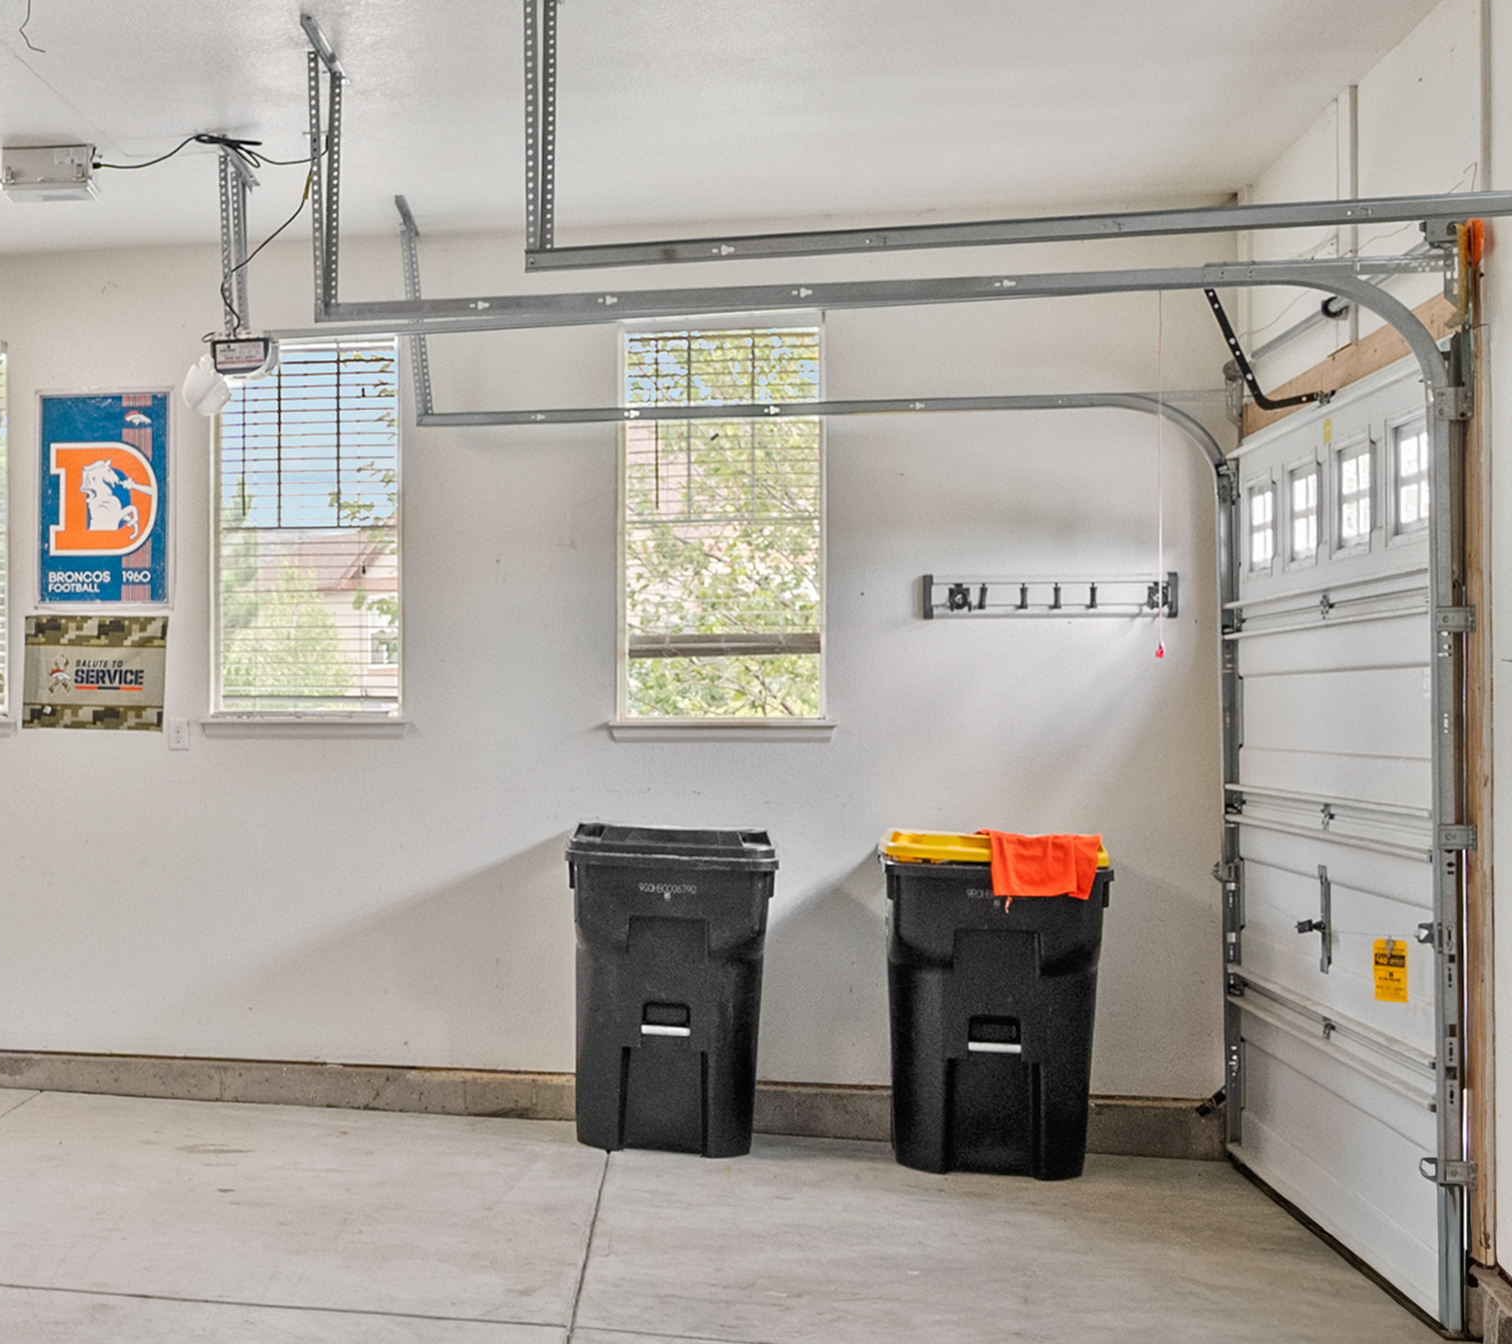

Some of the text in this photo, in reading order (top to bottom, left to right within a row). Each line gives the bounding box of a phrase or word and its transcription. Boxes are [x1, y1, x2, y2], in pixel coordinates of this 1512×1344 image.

[48, 571, 151, 583] BRONCOS 1960
[48, 583, 100, 593] FOOTBALL
[75, 660, 123, 668] SALUTE TO
[74, 669, 144, 685] SERVICE
